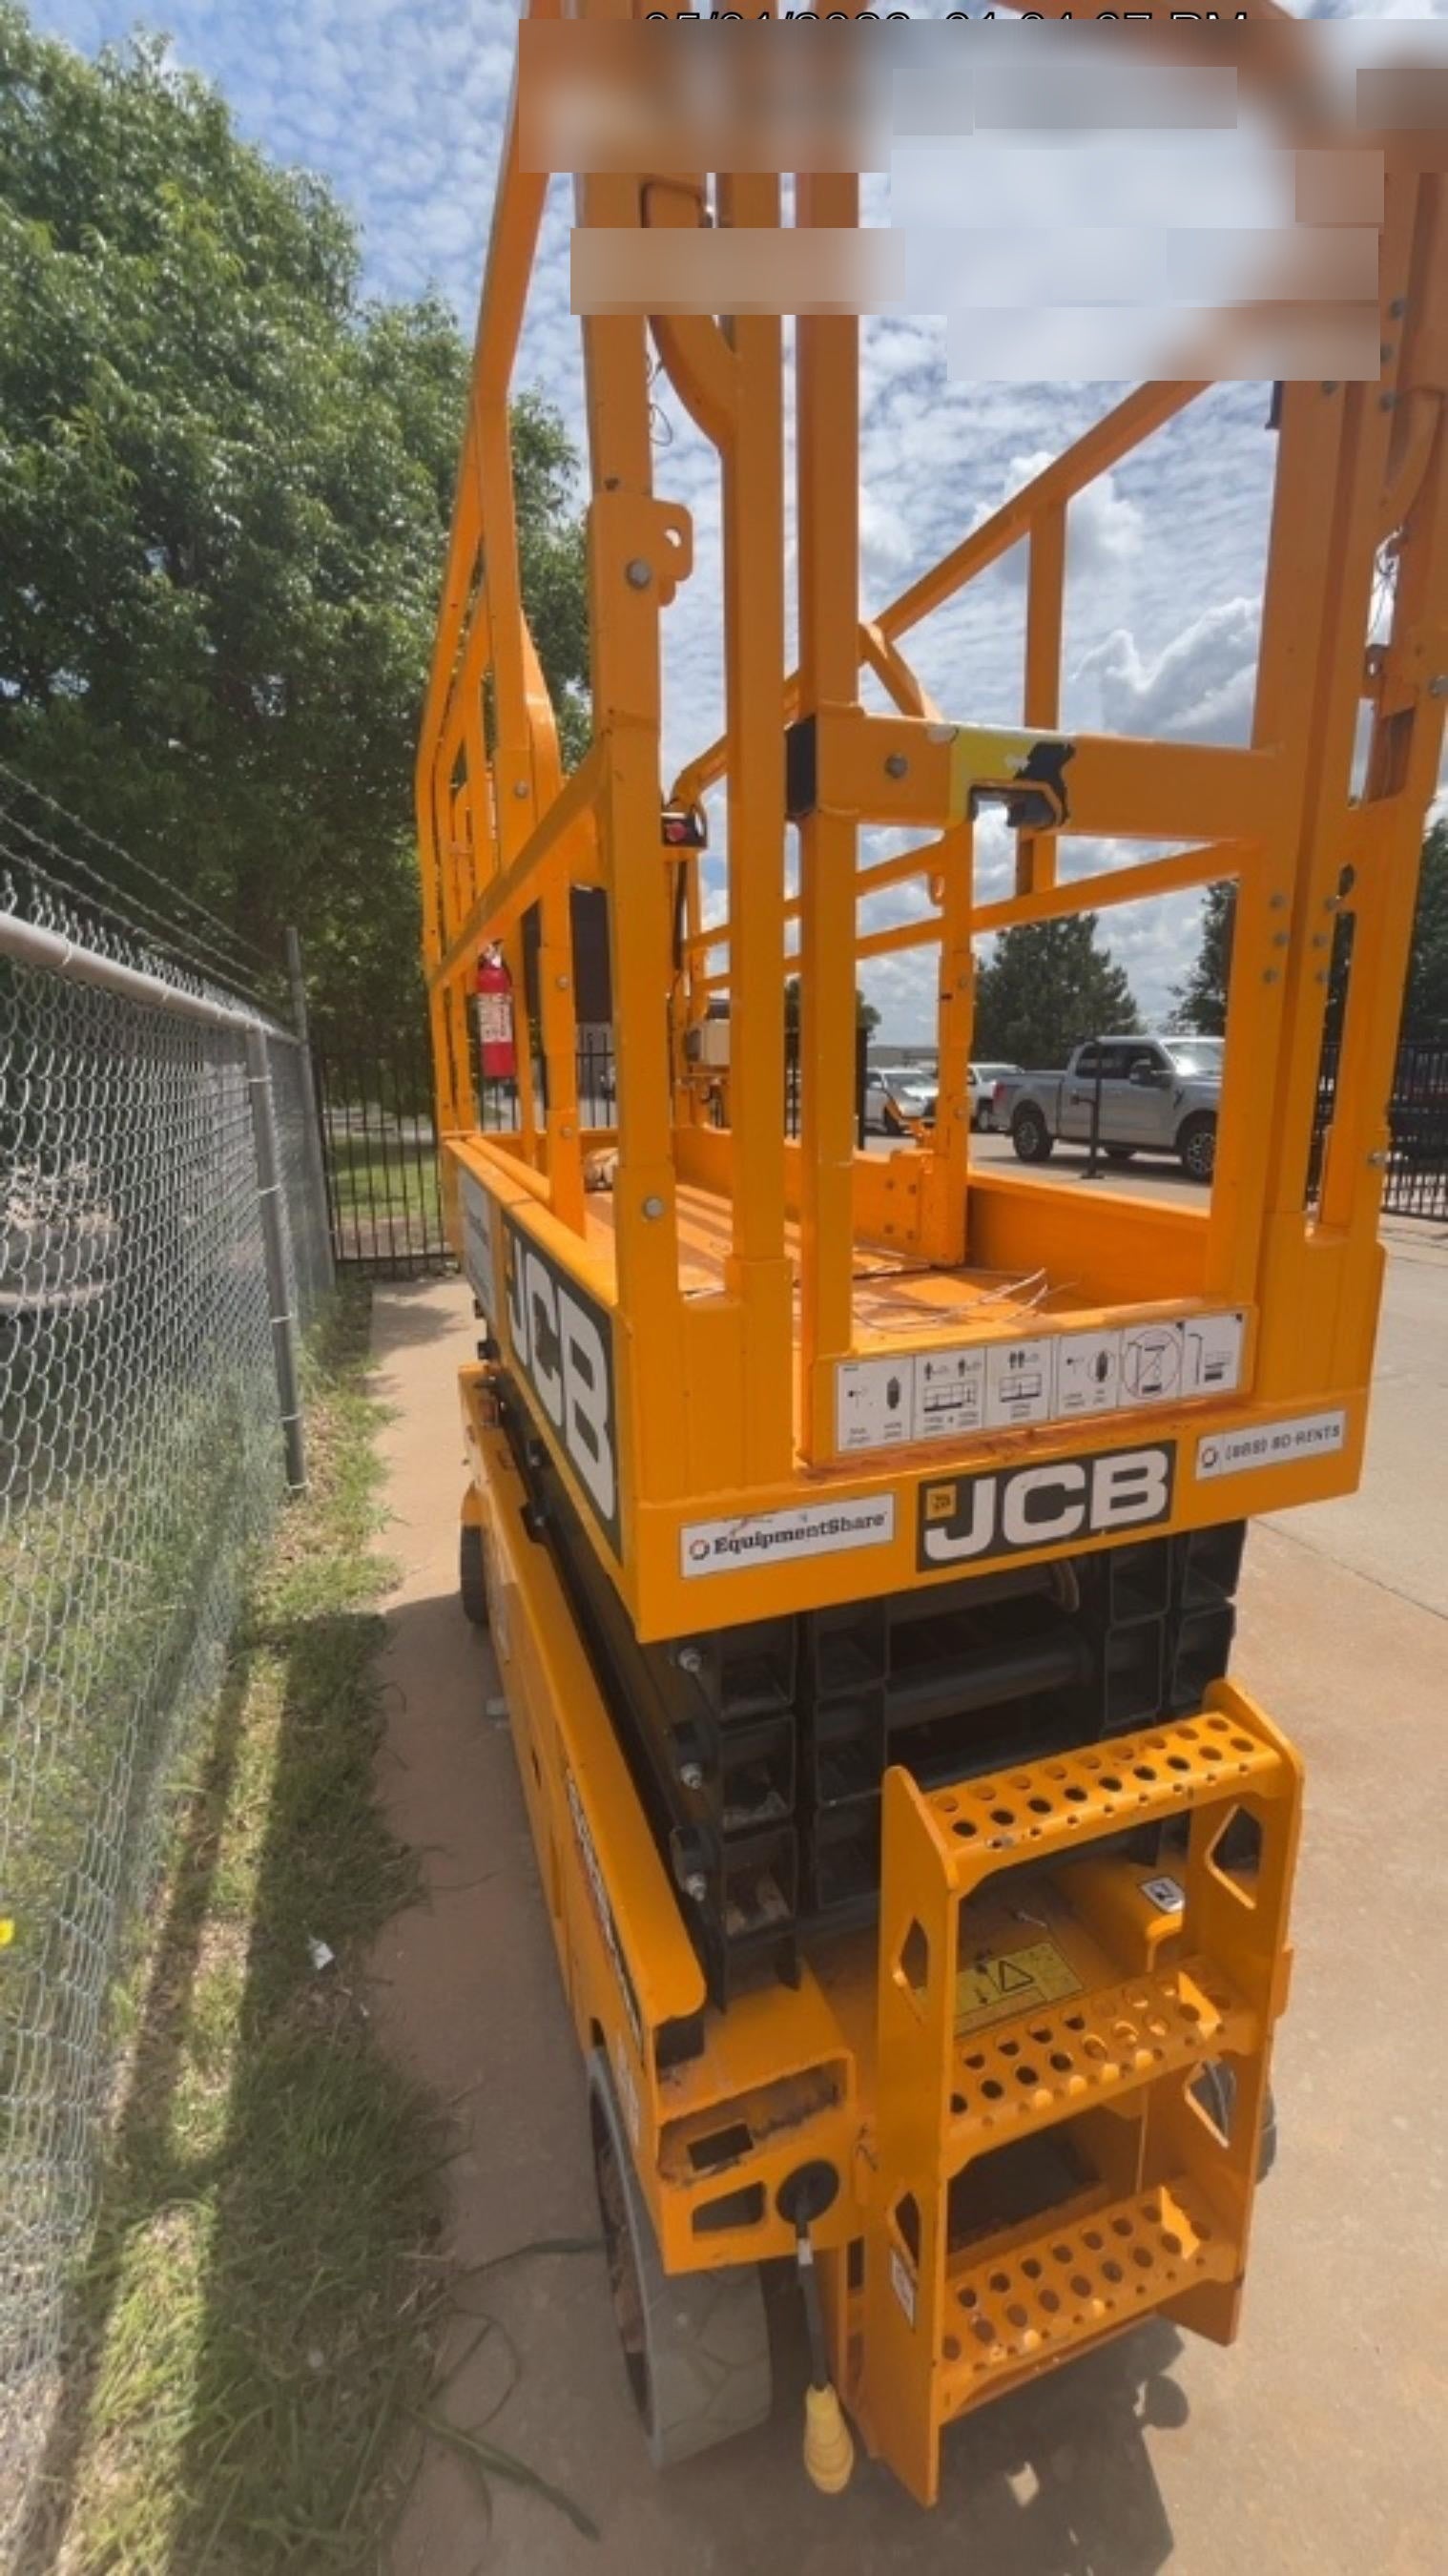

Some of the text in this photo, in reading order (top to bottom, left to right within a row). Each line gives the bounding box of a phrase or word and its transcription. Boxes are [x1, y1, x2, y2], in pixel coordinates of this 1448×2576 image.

[508, 1236, 617, 1520] JCB
[714, 1511, 886, 1555] EquipmentShare
[924, 1449, 1169, 1561] JCB
